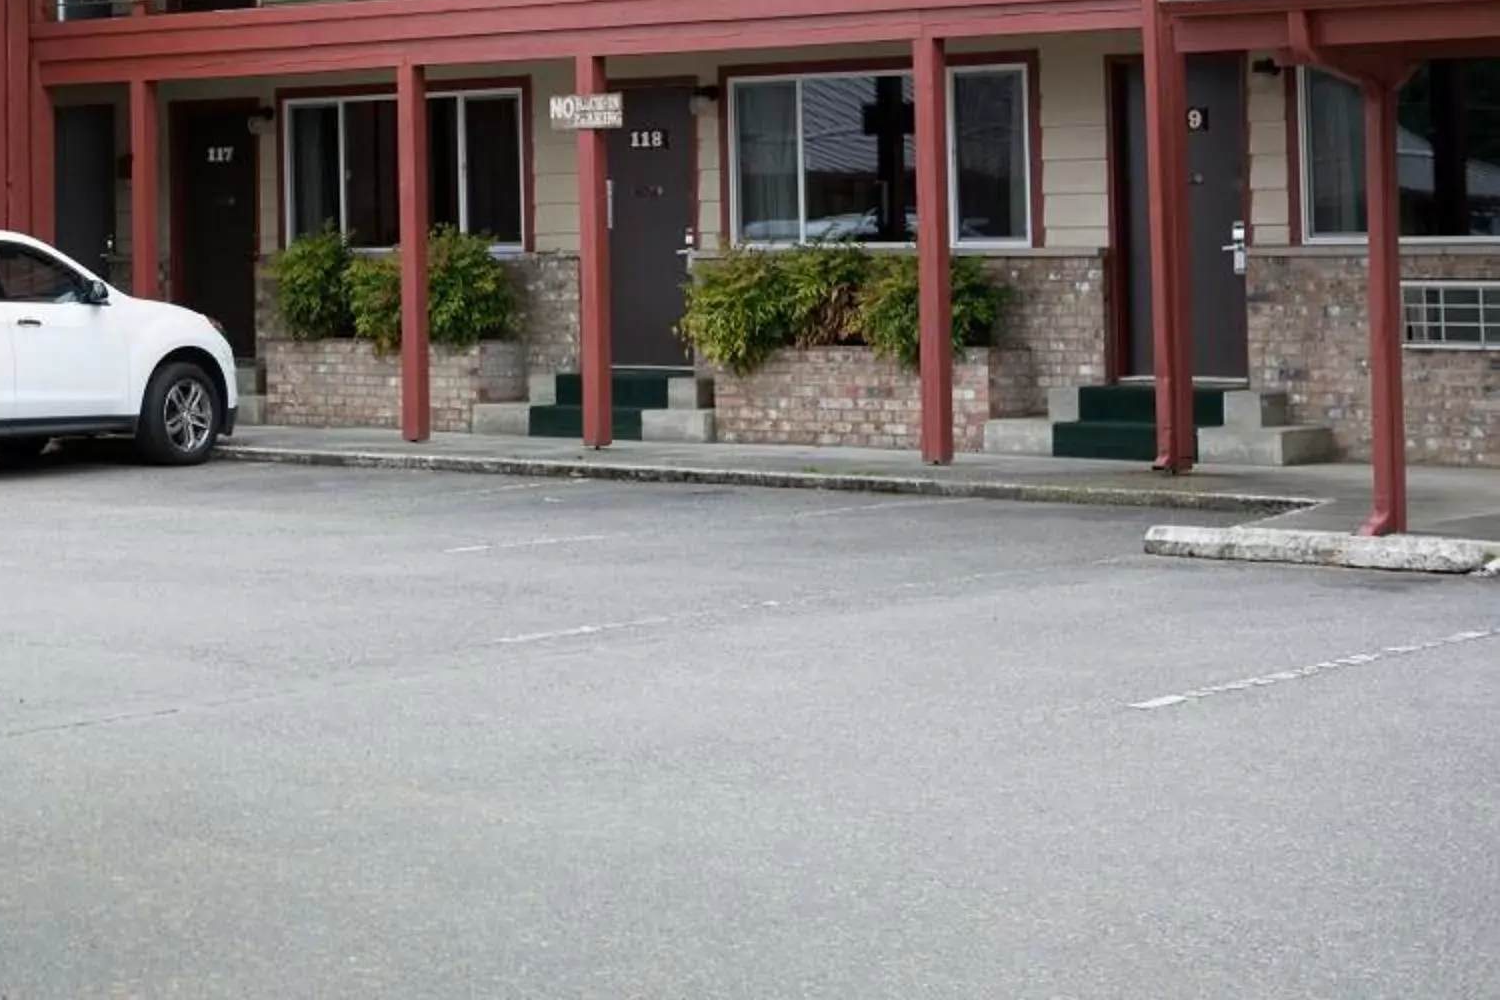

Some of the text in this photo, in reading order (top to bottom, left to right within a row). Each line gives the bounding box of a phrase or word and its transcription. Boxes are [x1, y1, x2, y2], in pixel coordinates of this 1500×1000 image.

[549, 96, 575, 119] NO
[631, 131, 662, 147] 118
[208, 146, 233, 162] 117
